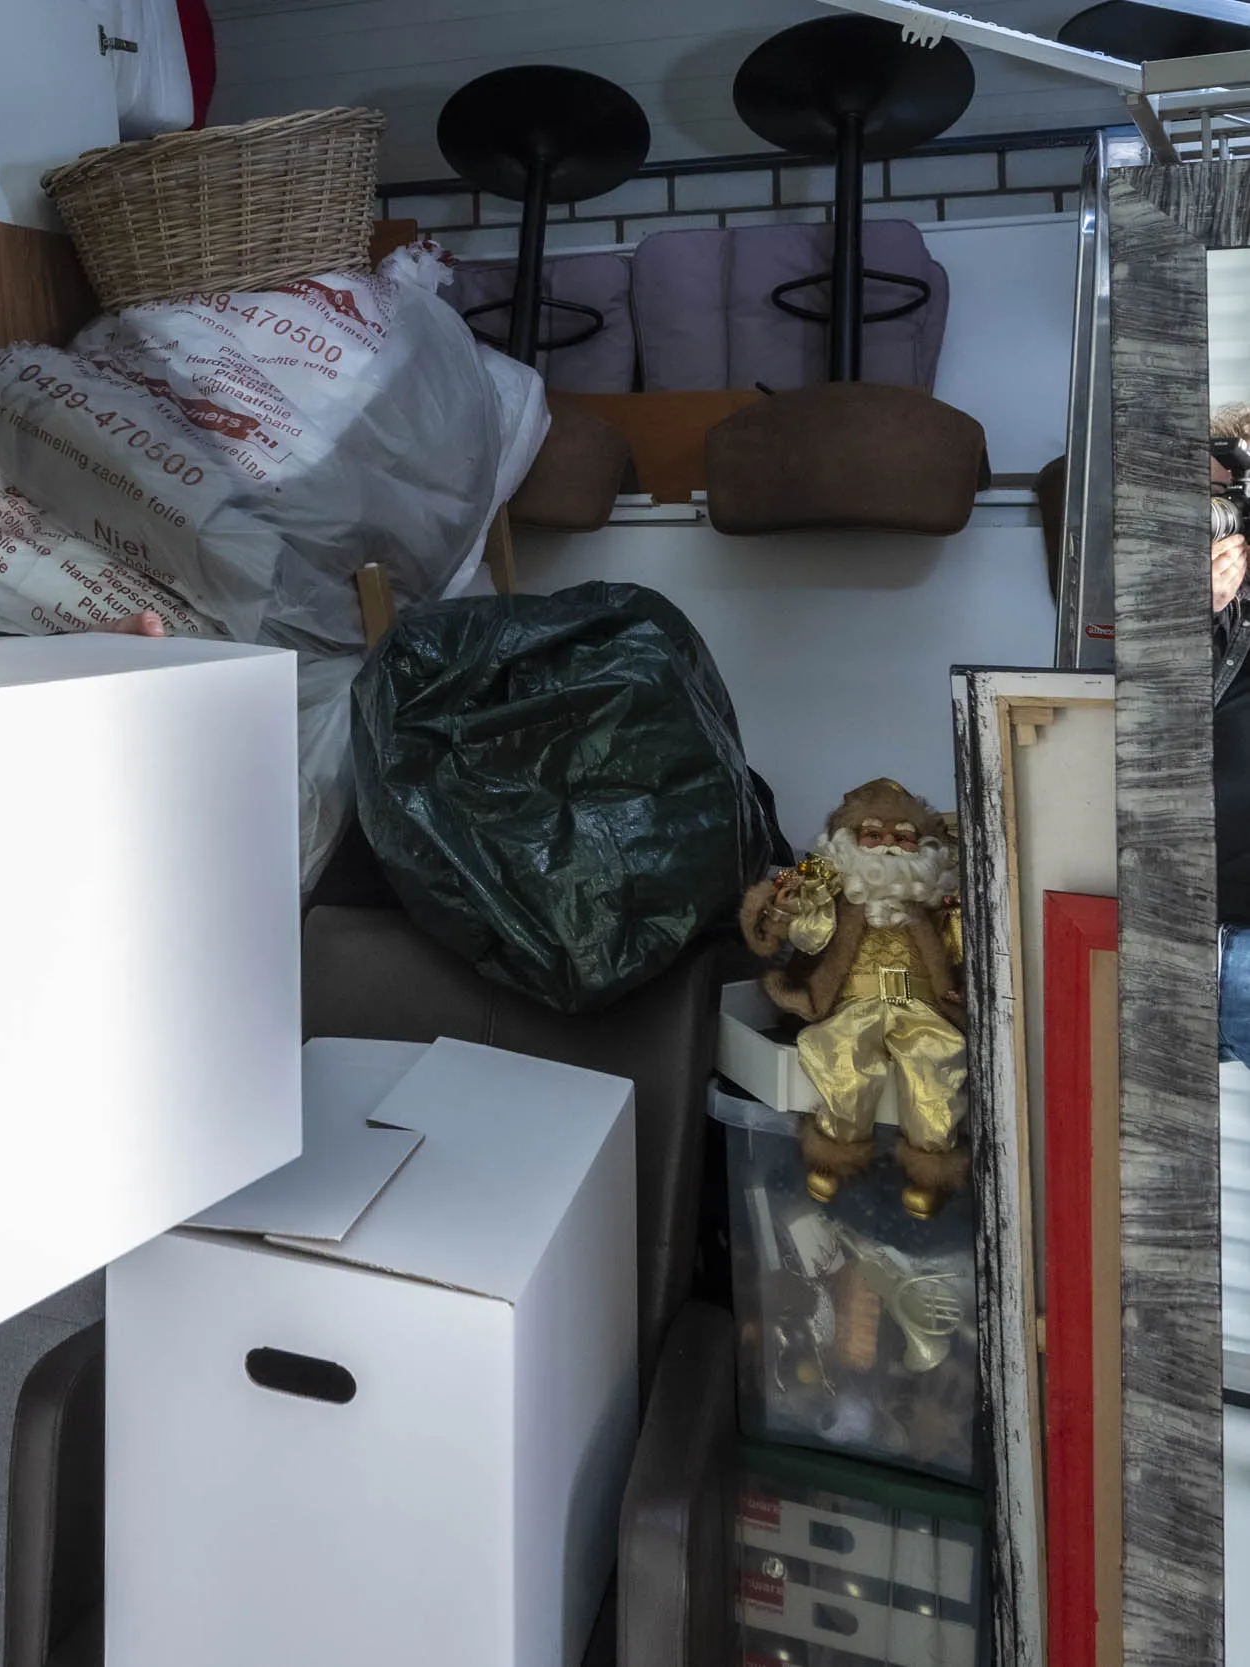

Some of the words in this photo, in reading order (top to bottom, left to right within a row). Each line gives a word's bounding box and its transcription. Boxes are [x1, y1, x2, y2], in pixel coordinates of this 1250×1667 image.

[9, 410, 88, 470] inzameling
[91, 460, 145, 503] zachte
[148, 495, 187, 529] folie
[60, 560, 103, 595] Harde
